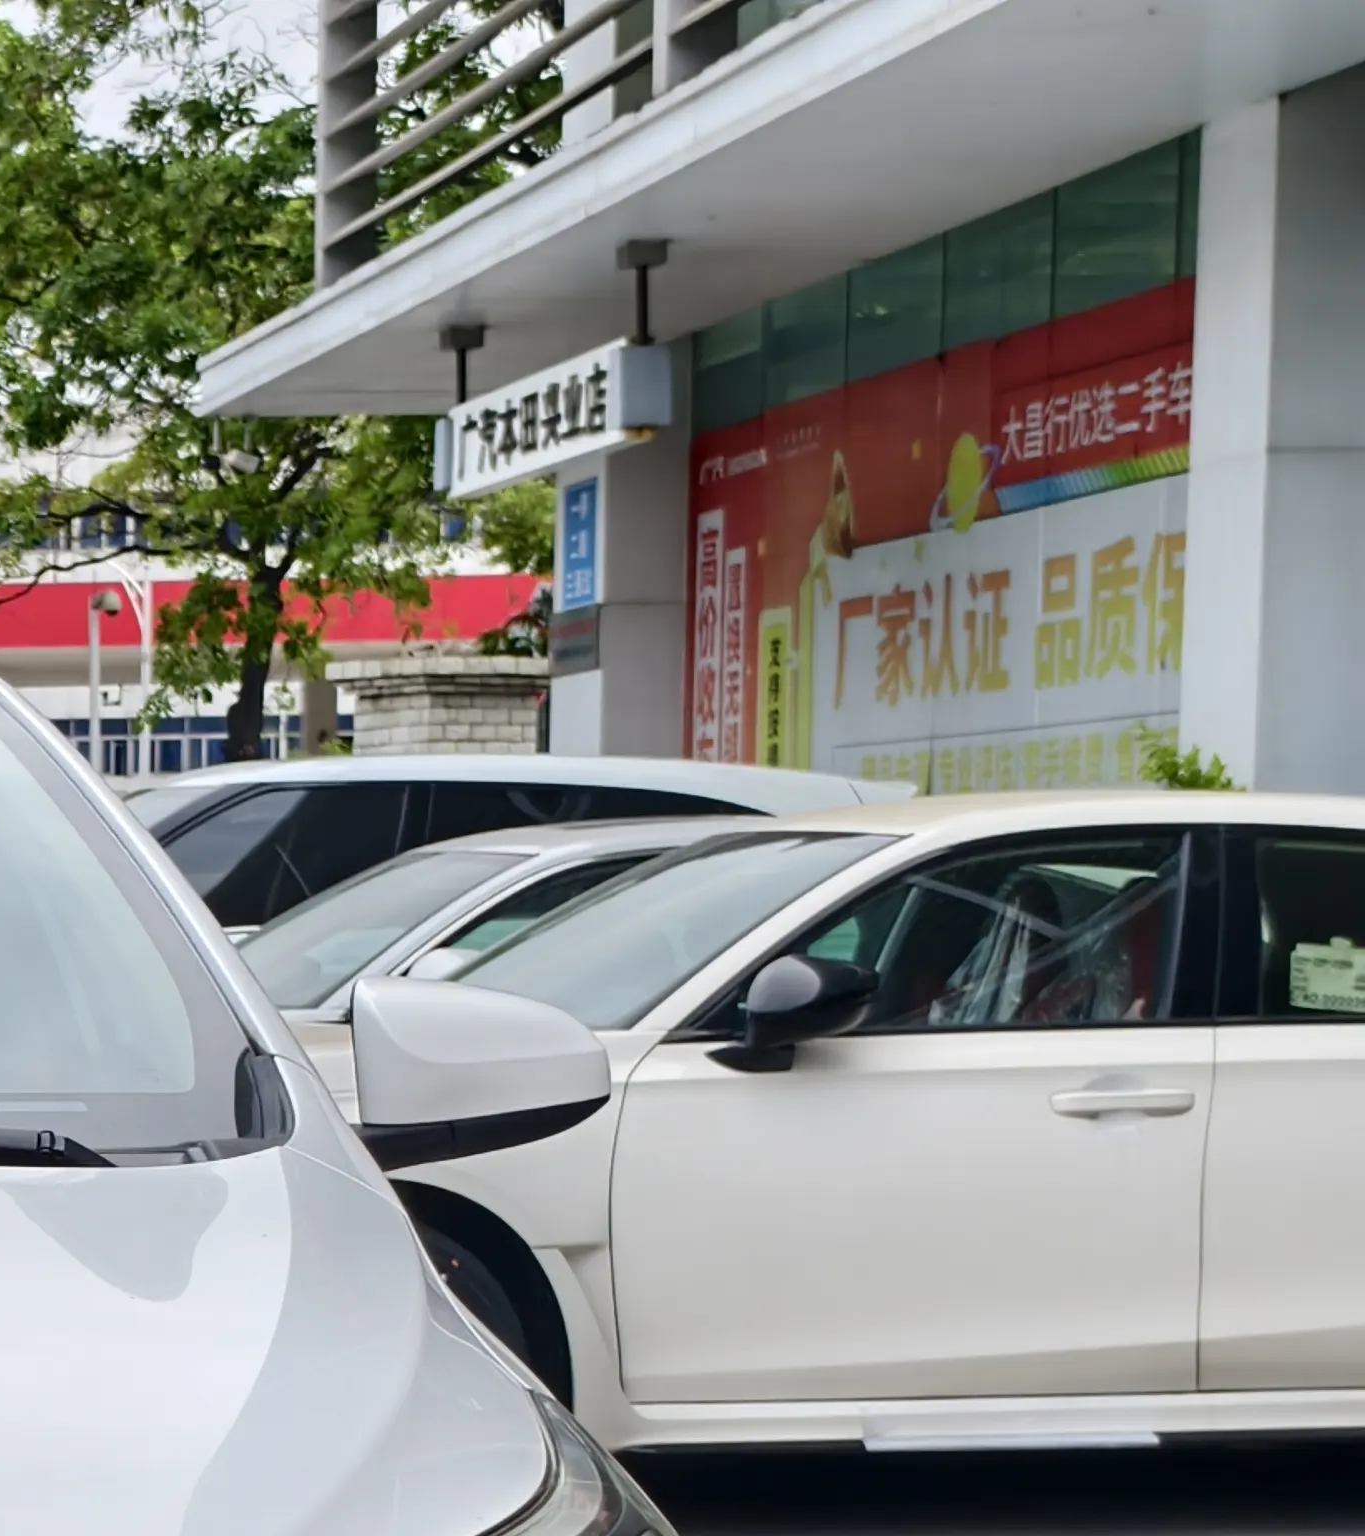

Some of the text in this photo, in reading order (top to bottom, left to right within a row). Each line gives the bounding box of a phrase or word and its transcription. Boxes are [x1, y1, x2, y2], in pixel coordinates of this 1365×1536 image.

[1000, 361, 1193, 465] 大昌行优选二手车
[833, 568, 1011, 711] 厂家认证
